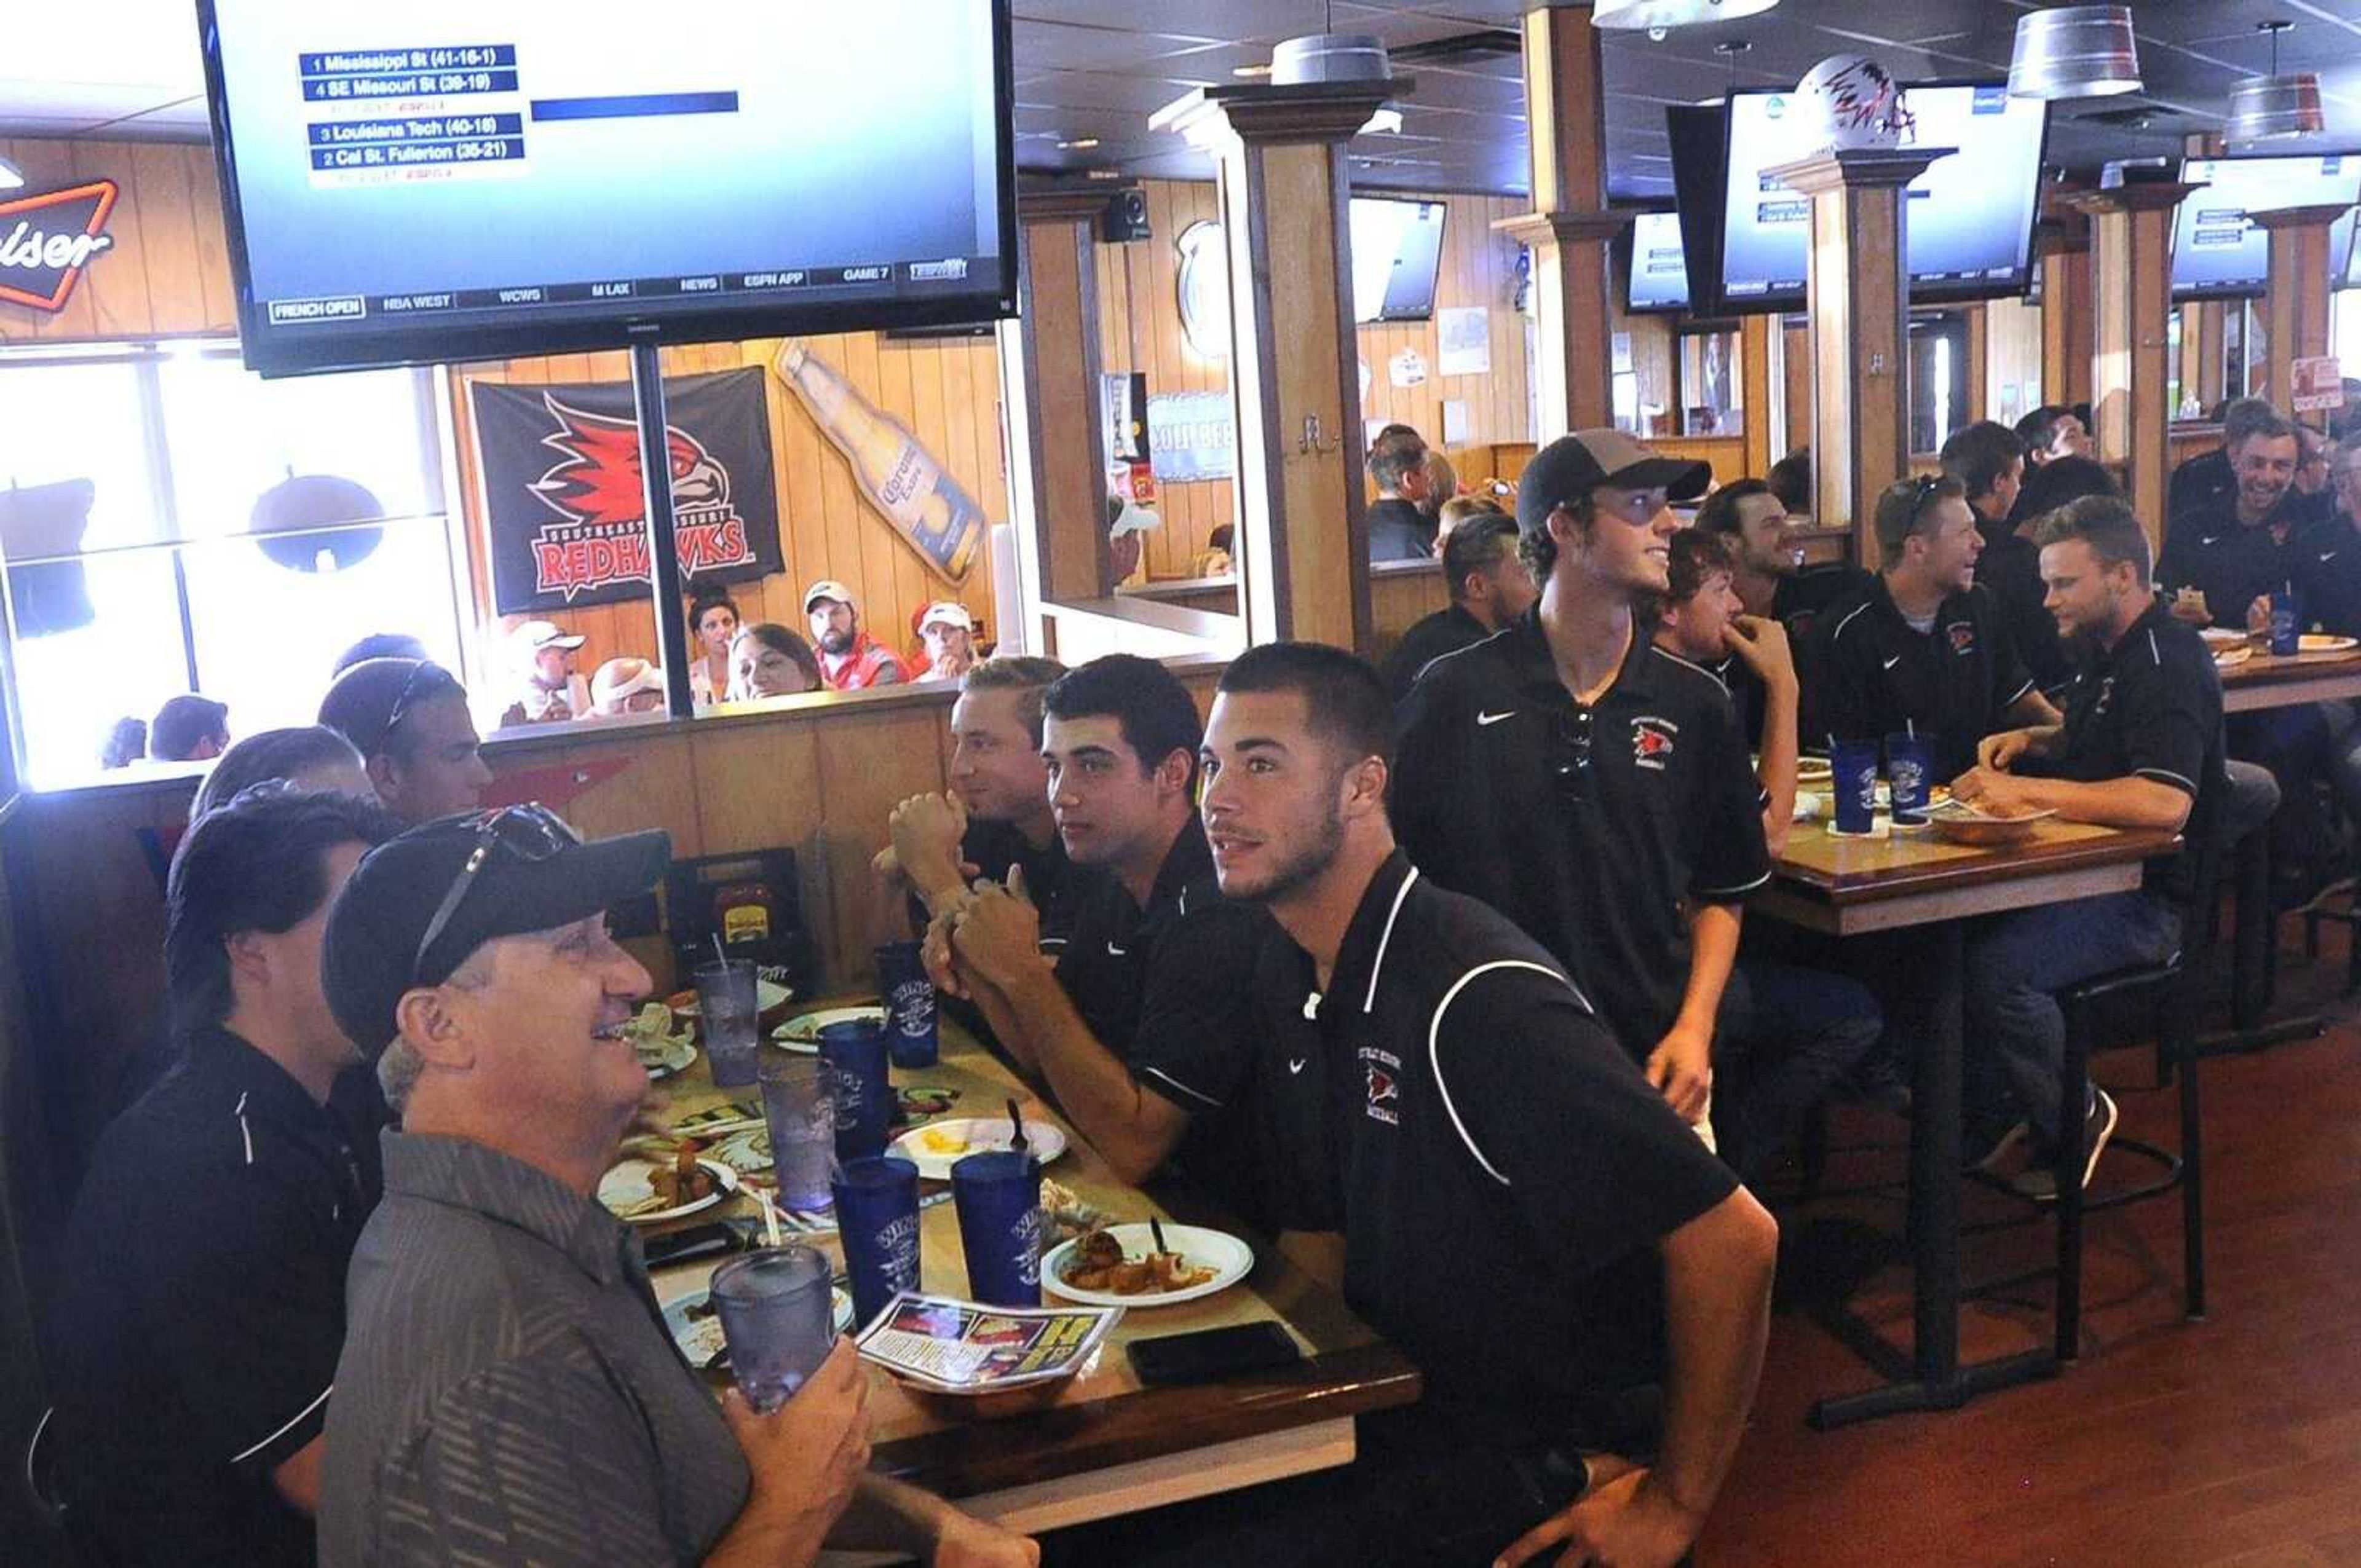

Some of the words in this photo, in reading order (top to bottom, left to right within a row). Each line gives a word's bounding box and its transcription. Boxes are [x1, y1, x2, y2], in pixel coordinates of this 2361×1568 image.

[314, 58, 320, 72] 1
[325, 52, 408, 72] Mississippi
[411, 51, 427, 68] St
[316, 83, 325, 97] 4
[328, 81, 349, 97] SE
[354, 77, 416, 95] Missouri
[419, 76, 437, 92] St
[333, 123, 403, 141] Louisiana
[406, 120, 442, 136] Tech
[324, 152, 334, 166] 2
[336, 149, 361, 165] Cal
[388, 145, 453, 162] Fullerton
[680, 277, 718, 291] NEWS
[743, 273, 777, 287] ESPN
[779, 272, 804, 285] APP
[844, 267, 879, 281] GAME
[274, 302, 323, 318] FRENCH
[326, 299, 359, 315] OPEN
[383, 296, 411, 310] NBA
[413, 293, 451, 309] WEST
[549, 520, 644, 542] SOUTHEAST
[539, 520, 746, 585] REDHWKS
